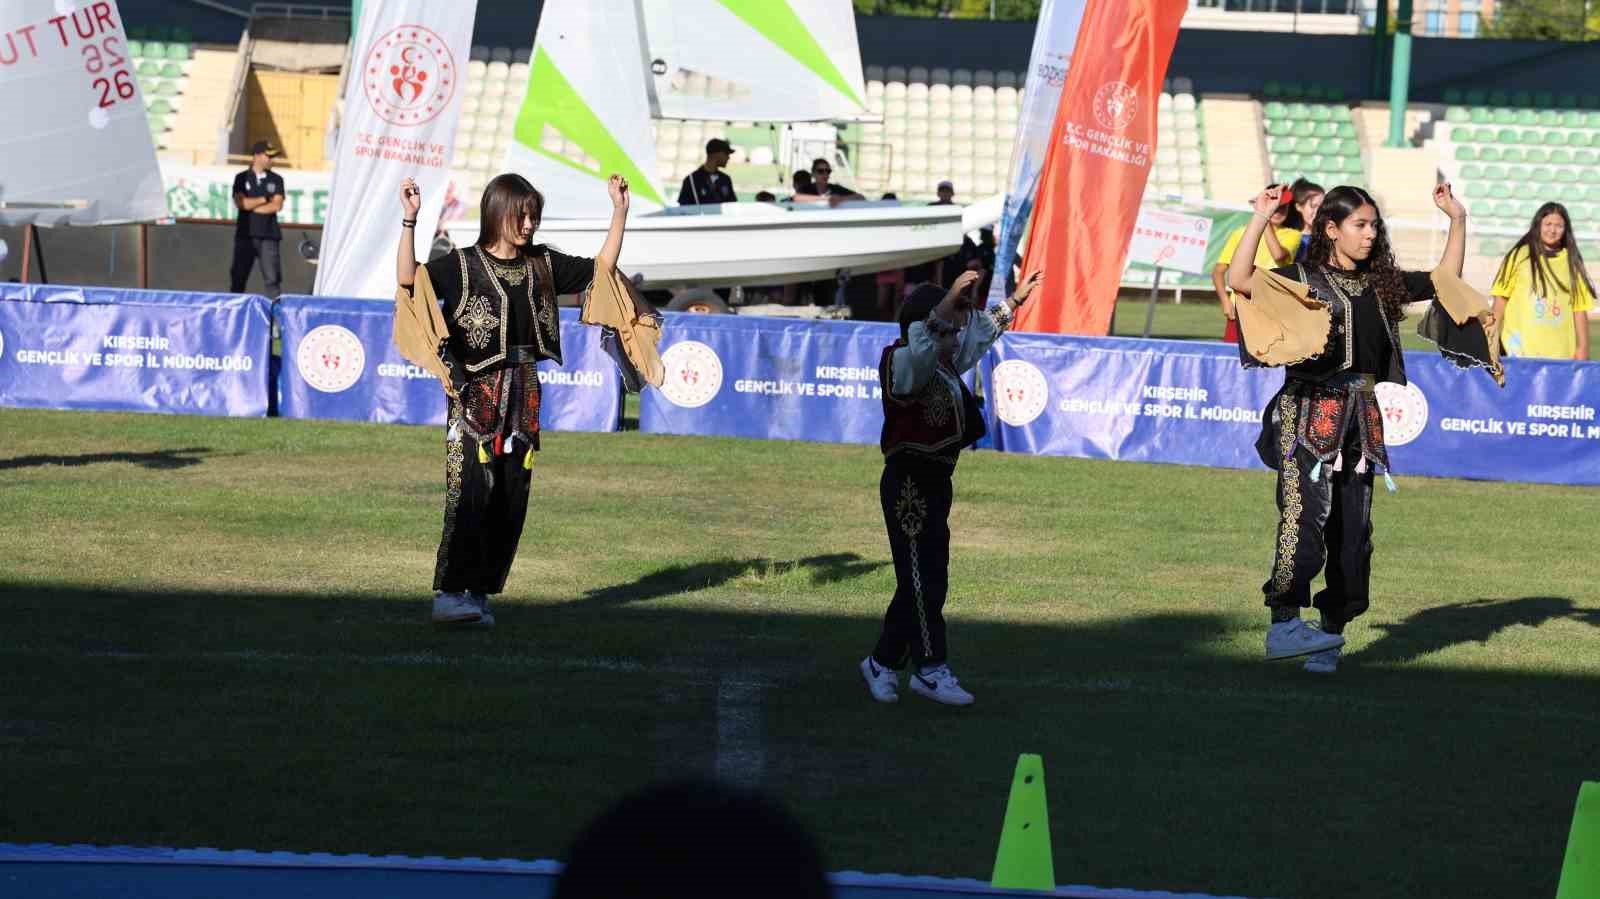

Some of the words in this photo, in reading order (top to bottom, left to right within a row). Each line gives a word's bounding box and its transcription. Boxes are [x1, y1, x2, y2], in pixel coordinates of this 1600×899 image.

[48, 2, 116, 47] TUR
[92, 69, 134, 108] 26
[431, 144, 445, 155] VE
[1136, 143, 1153, 155] VE
[83, 352, 102, 366] VE
[104, 353, 144, 367] SPOR
[147, 352, 160, 368] İL
[816, 366, 880, 381] KIRŞEHİR
[735, 379, 793, 396] GENÇLİK
[798, 383, 815, 396] VE
[817, 383, 854, 397] SPOR
[857, 383, 870, 399] İL
[1124, 402, 1142, 416] VE
[1143, 402, 1182, 418] SPOR
[1184, 403, 1198, 420] İL
[1527, 404, 1595, 420] KIRŞEHİR
[1441, 417, 1503, 434] GENÇLİK
[1507, 422, 1526, 435] VE
[1529, 422, 1569, 437] SPOR
[1571, 421, 1585, 438] İL
